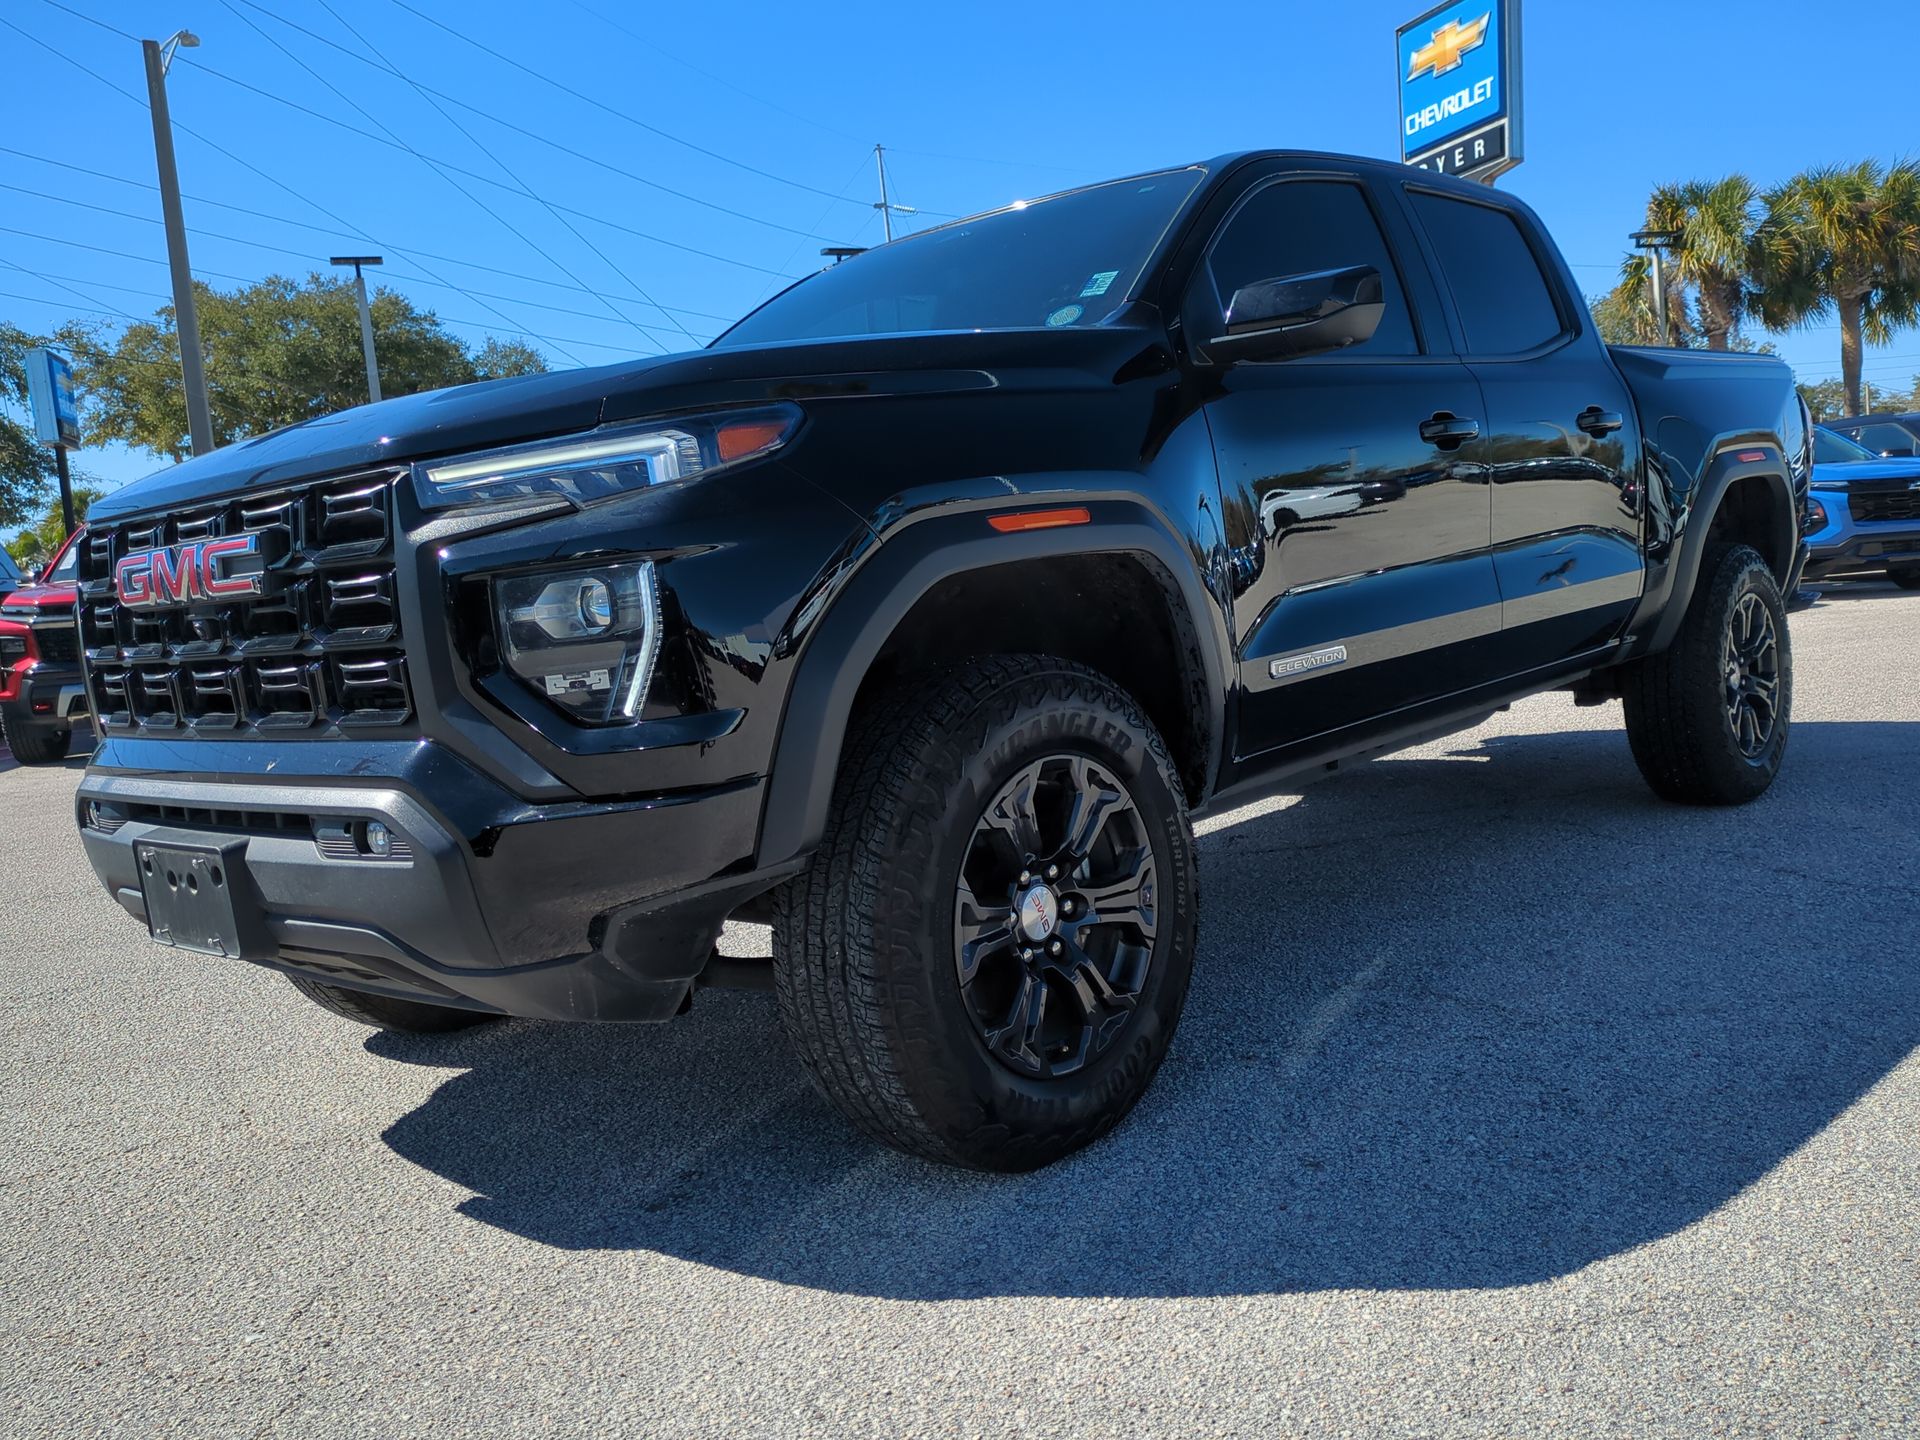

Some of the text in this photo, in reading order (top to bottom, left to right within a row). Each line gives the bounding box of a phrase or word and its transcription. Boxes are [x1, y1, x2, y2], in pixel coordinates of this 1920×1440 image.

[1405, 76, 1494, 136] CHEVROLET
[1419, 138, 1486, 174] YER
[116, 534, 264, 611] GMC
[1278, 651, 1343, 673] ELEVATION
[983, 711, 1134, 771] WRANGLER
[1164, 812, 1188, 920] TERRITORY
[1030, 892, 1051, 934] GMC
